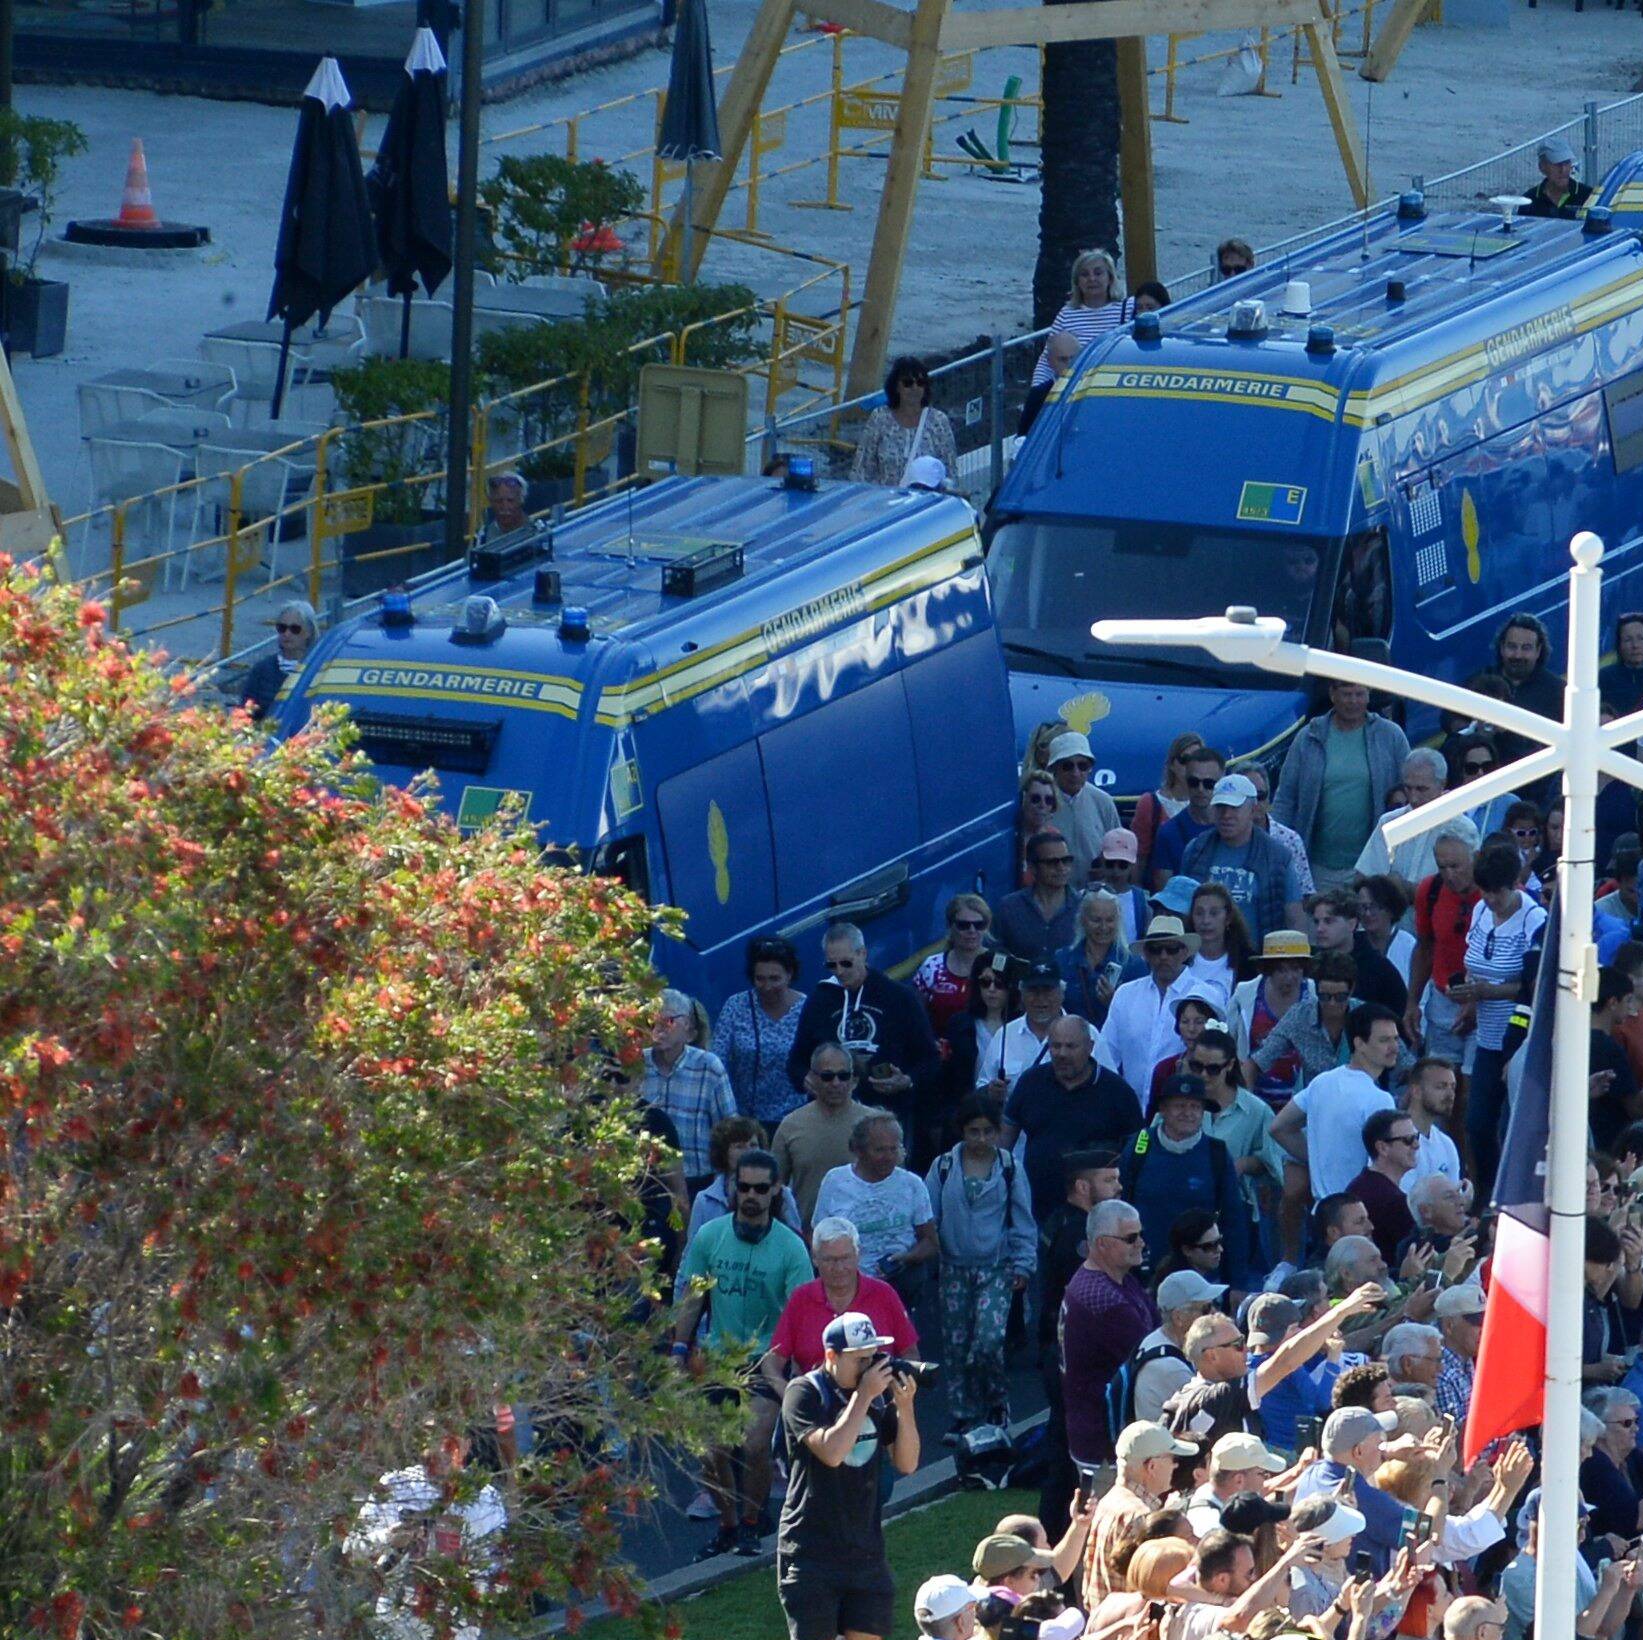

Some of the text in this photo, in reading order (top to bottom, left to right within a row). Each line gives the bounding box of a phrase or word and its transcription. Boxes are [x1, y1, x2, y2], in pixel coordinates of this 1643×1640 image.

[1485, 304, 1573, 367] GENDARMERIE
[1123, 373, 1284, 397] GENDARMERIE
[1287, 490, 1299, 504] E
[363, 669, 537, 697] GENDARMERIE
